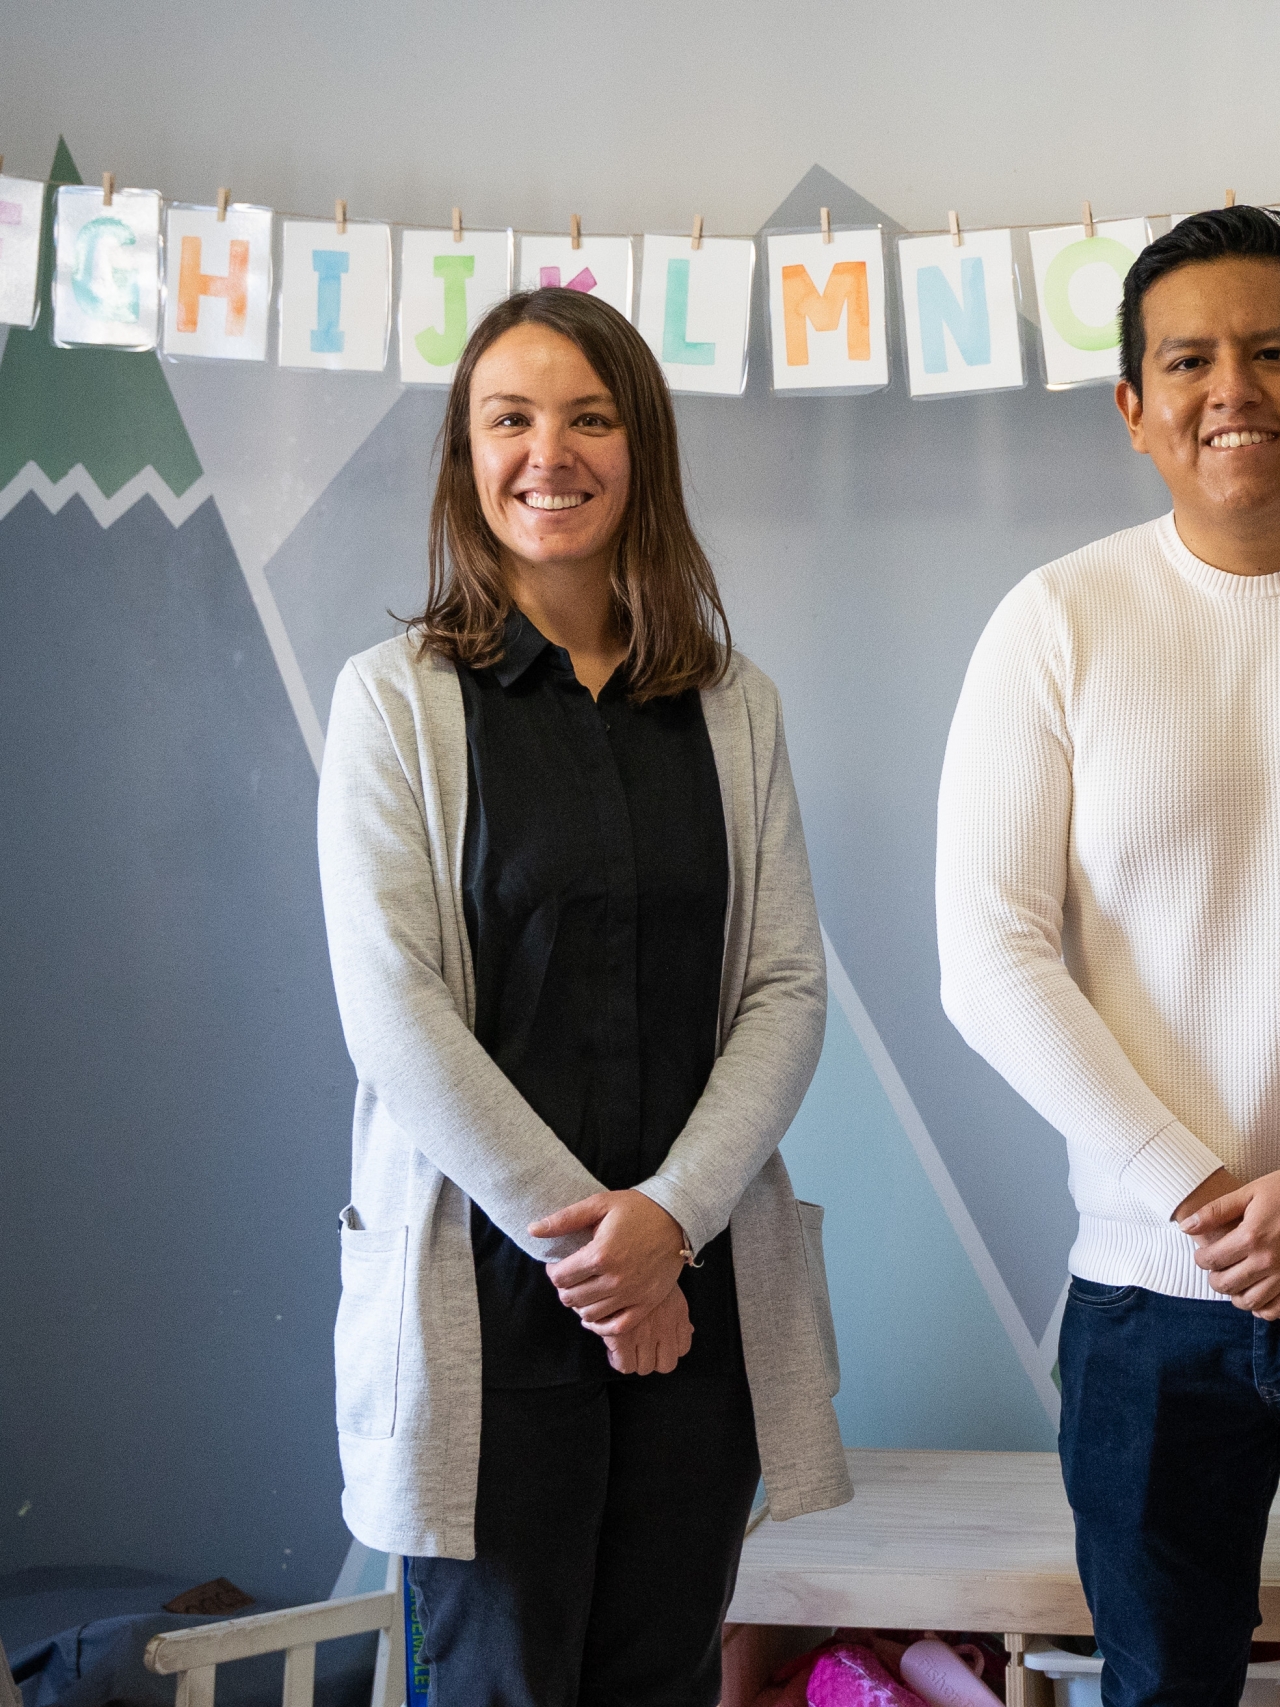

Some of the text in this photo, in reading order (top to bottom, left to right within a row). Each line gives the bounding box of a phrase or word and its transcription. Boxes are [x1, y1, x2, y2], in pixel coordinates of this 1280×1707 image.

[72, 216, 140, 324] G
[176, 235, 249, 337] H
[310, 249, 350, 353] I
[413, 255, 475, 367] J
[662, 258, 716, 366] L
[781, 260, 871, 367] M
[916, 256, 992, 374] N
[1043, 236, 1139, 352] O
